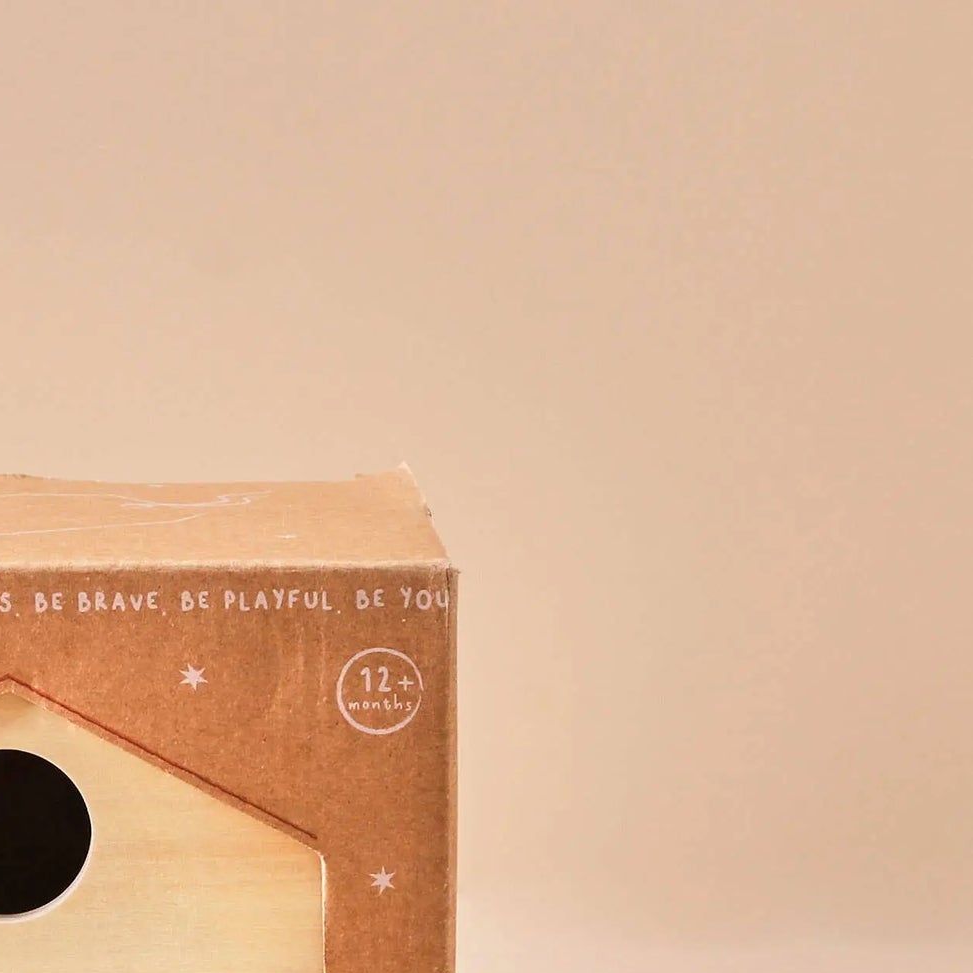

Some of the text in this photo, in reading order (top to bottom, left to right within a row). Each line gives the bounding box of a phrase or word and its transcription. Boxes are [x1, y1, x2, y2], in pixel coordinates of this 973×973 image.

[34, 591, 64, 614] BE
[180, 590, 210, 612] BE
[355, 588, 385, 610] BE
[399, 586, 450, 611] YOU
[360, 666, 415, 693] 12+
[348, 693, 413, 711] months
